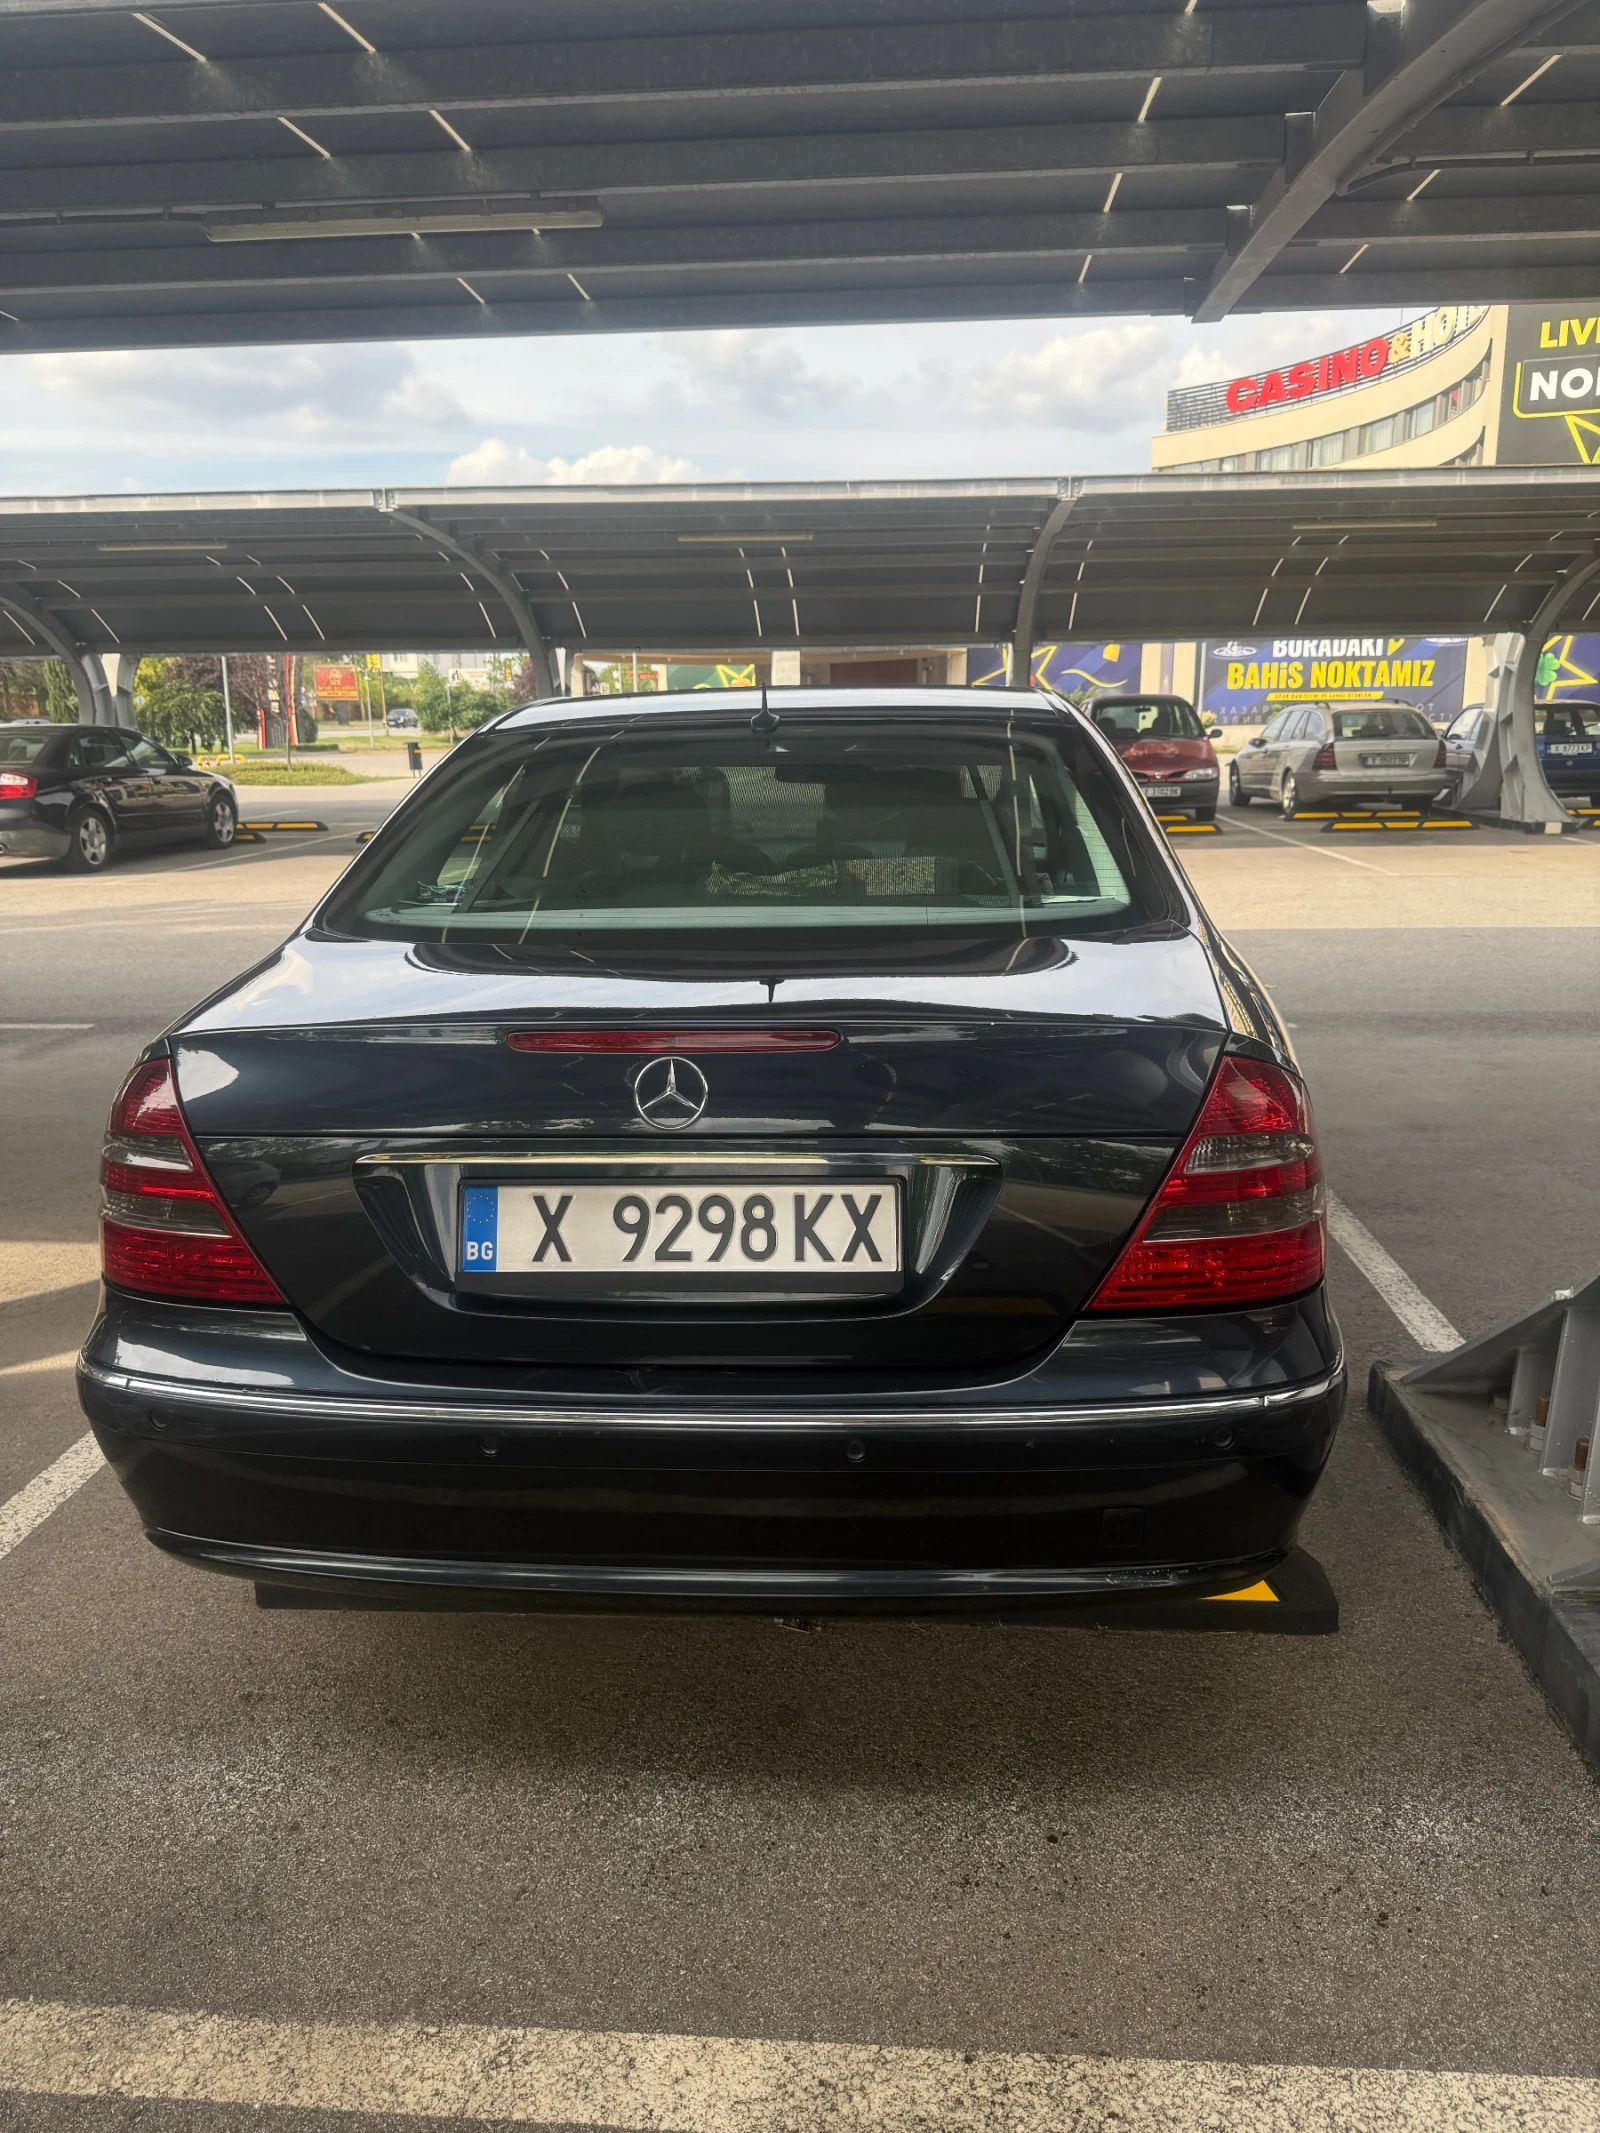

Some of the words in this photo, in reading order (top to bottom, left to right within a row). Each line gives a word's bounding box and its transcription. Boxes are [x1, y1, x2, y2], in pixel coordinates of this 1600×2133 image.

[1540, 317, 1600, 348] LIV
[1226, 336, 1390, 413] CASINO
[1388, 331, 1410, 363] &
[1529, 367, 1600, 401] NO
[1310, 659, 1436, 688] NOKTAMIZ
[466, 1241, 494, 1261] BG
[531, 1194, 574, 1263] X
[613, 1193, 778, 1263] 9298
[793, 1193, 883, 1263] KX
